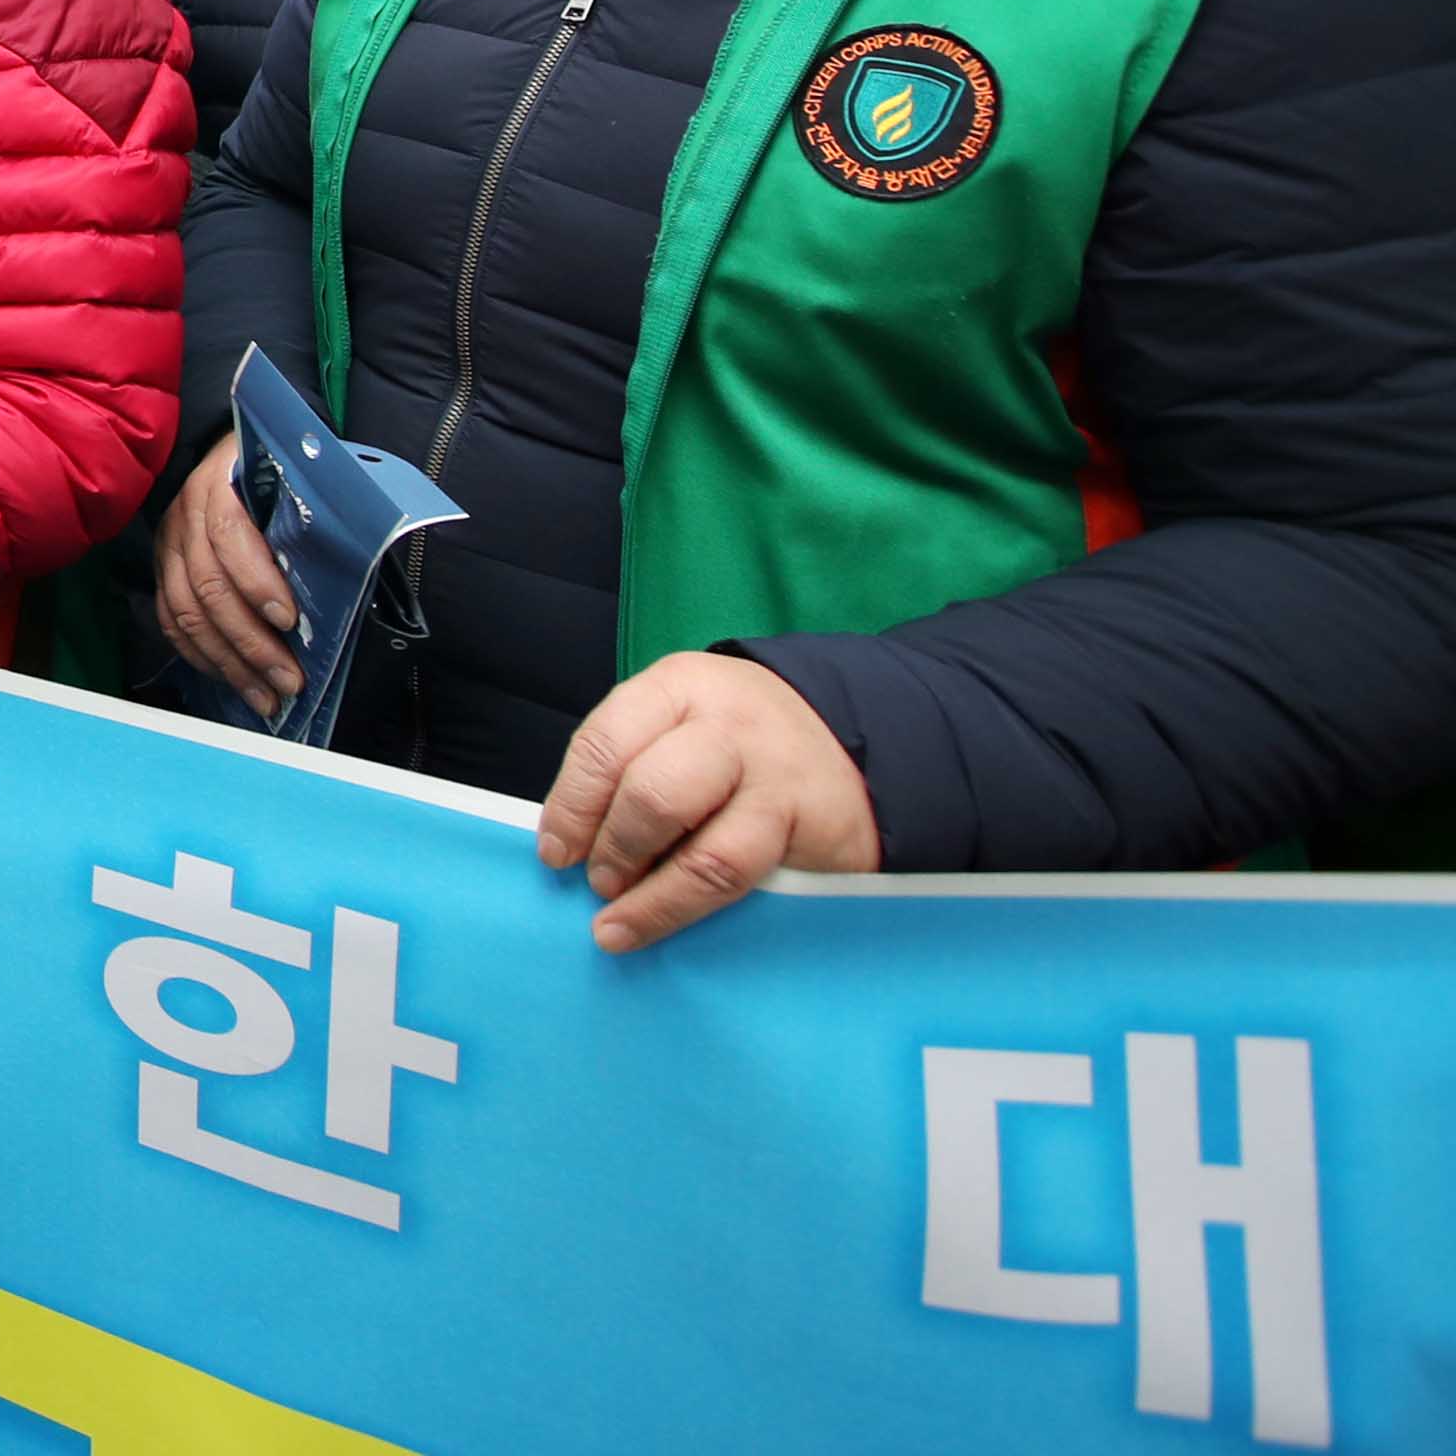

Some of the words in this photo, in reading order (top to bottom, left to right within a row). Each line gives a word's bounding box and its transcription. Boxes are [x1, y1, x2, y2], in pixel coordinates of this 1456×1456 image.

[840, 32, 902, 62] CORPS
[904, 32, 971, 65] ACTIVE
[959, 57, 983, 80] IN
[803, 55, 844, 115] CITIZEN
[960, 73, 996, 160] DISASTER
[805, 121, 959, 192] 전국자율방재단
